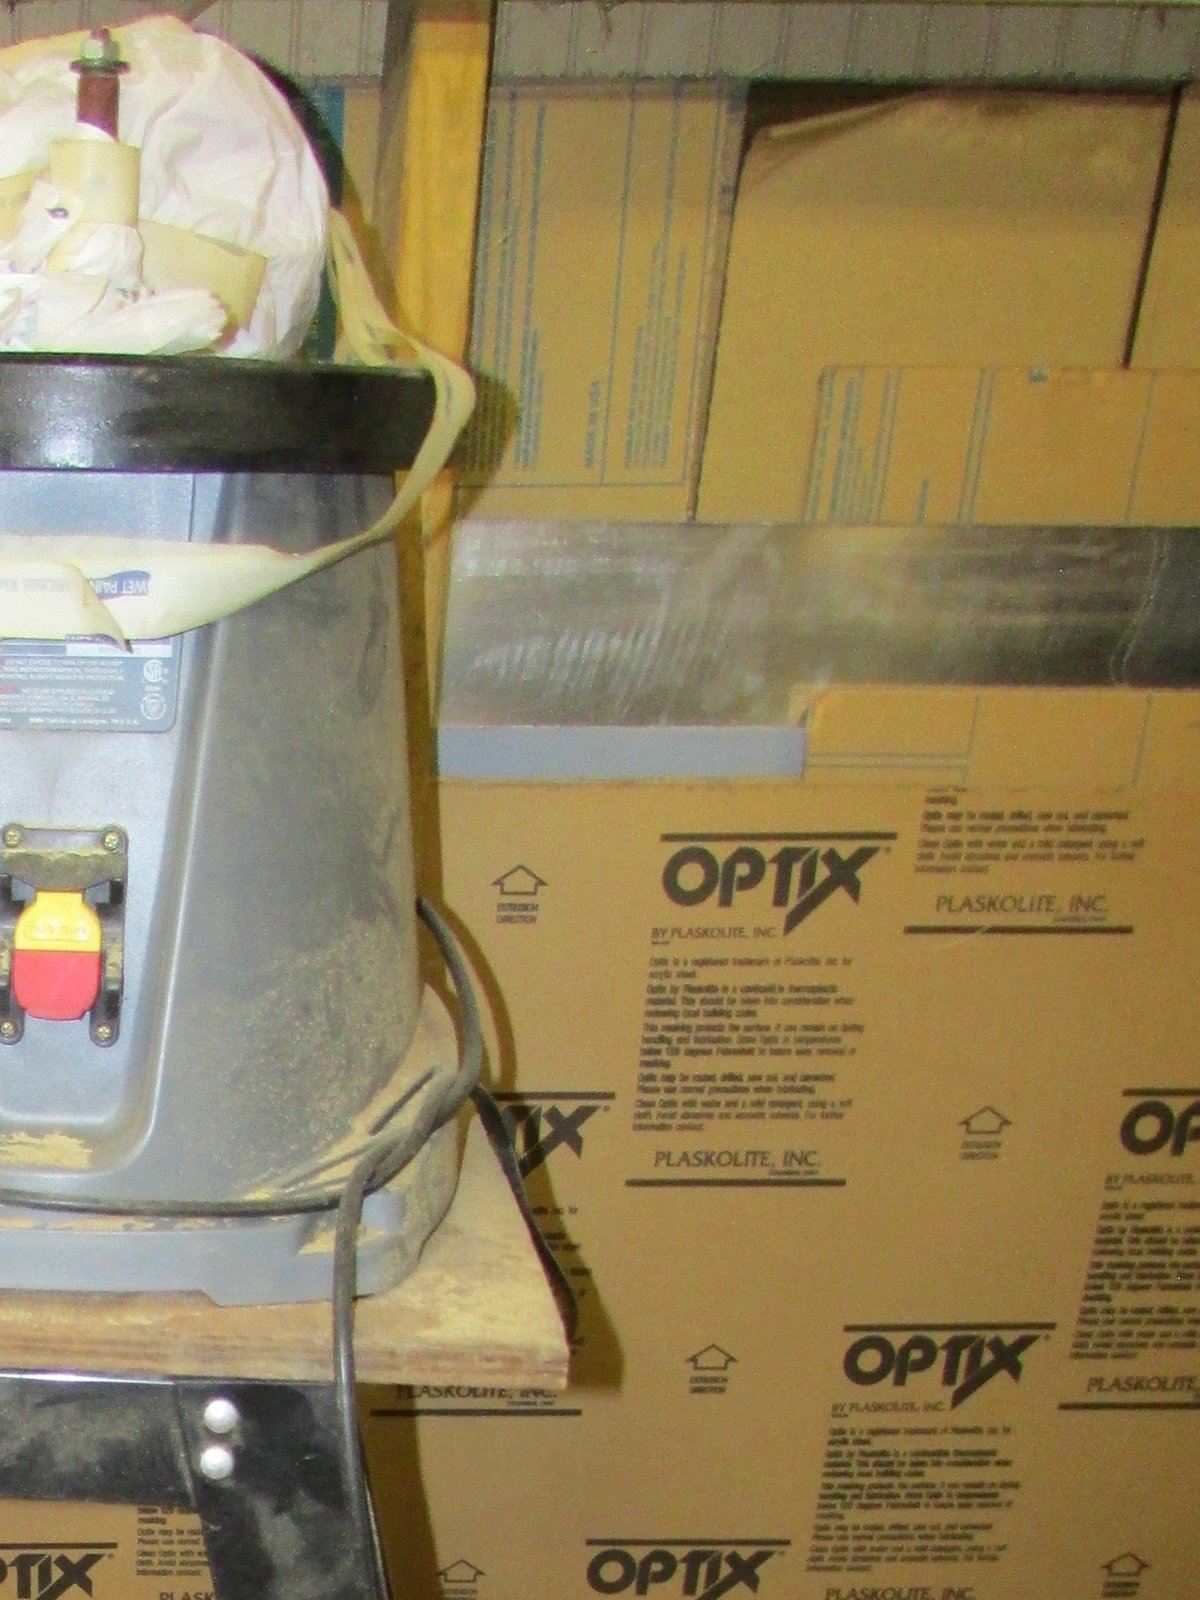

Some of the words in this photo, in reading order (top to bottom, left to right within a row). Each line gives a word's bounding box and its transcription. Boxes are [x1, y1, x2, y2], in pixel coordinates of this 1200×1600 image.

[122, 579, 148, 594] WET
[662, 845, 880, 937] OPTIX
[935, 894, 1062, 913] PLASKOLITE,
[1069, 894, 1108, 913] INC.
[671, 927, 748, 939] PLASKOLITE,
[654, 1150, 775, 1170] PLASKOLITE,
[782, 1150, 820, 1167] INC.
[843, 1335, 1041, 1411] OPTIX
